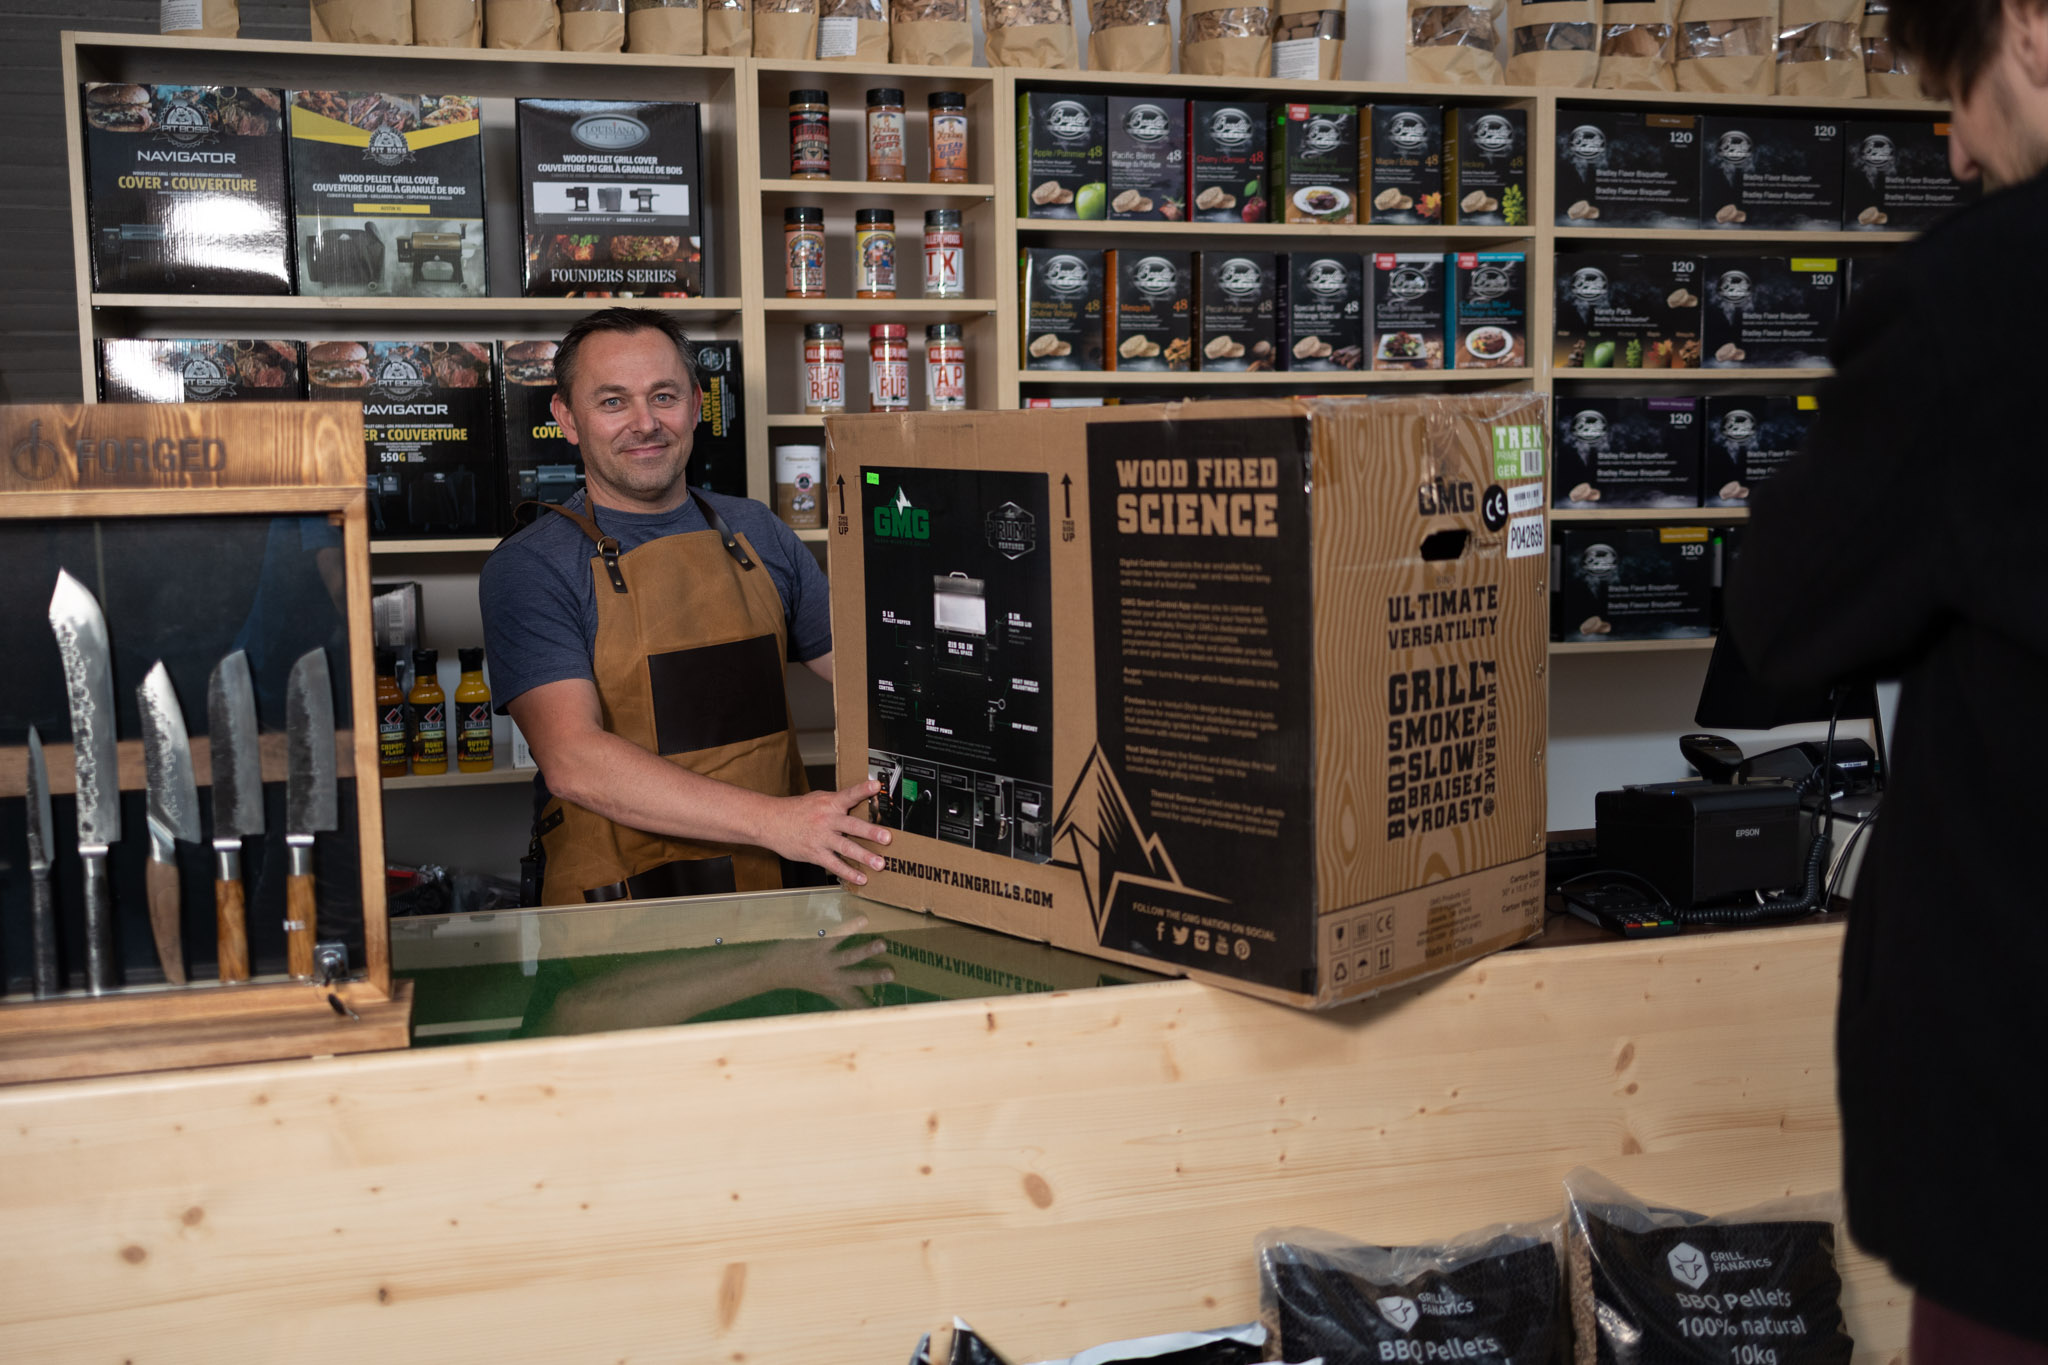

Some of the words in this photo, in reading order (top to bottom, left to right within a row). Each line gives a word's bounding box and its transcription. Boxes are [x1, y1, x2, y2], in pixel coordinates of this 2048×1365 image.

[179, 125, 209, 133] BOSS
[584, 124, 637, 136] LOUISIANA
[1814, 125, 1836, 137] 120
[1670, 132, 1693, 144] 120
[371, 146, 385, 154] PIT
[1088, 146, 1103, 158] 48
[1112, 151, 1134, 160] Pacific
[1136, 151, 1156, 160] Blend
[1166, 150, 1182, 163] 48
[137, 150, 236, 164] NAVIGATOR
[563, 155, 588, 164] WOOD
[588, 156, 613, 164] PELLET
[614, 156, 633, 165] GRILL
[634, 156, 658, 165] COVER
[1250, 152, 1264, 164] 48
[1425, 154, 1440, 166] 48
[1510, 156, 1524, 168] 48
[538, 164, 585, 173] COUVERTURE
[586, 165, 597, 173] DU
[598, 165, 614, 174] GRIL
[614, 163, 621, 174] À
[622, 164, 654, 174] GRANULÉ
[655, 166, 665, 174] DE
[666, 166, 683, 175] BOIS
[118, 176, 161, 189] COVER
[171, 177, 257, 191] COUVERTURE
[339, 174, 364, 183] WOOD
[366, 174, 391, 184] PELLET
[392, 175, 413, 184] GRILL
[414, 176, 439, 185] COVER
[313, 183, 363, 193] COUVERTURE
[364, 184, 375, 193] DU
[376, 184, 393, 194] GRIL
[394, 183, 401, 195] À
[401, 184, 436, 195] GRANULÉ
[437, 186, 447, 195] DE
[448, 186, 466, 195] BOIS
[1672, 262, 1694, 273] 120
[551, 269, 624, 283] FOUNDERS
[627, 270, 677, 283] SERIES
[1812, 274, 1833, 286] 120
[1085, 300, 1100, 312] 48
[1173, 298, 1188, 312] 48
[1258, 301, 1273, 314] 48
[1317, 304, 1334, 312] Blend
[1344, 301, 1359, 314] 48
[1616, 308, 1632, 316] Pack
[808, 365, 840, 380] STEAK
[876, 364, 892, 376] THE
[811, 382, 840, 400] RUB
[880, 378, 907, 398] RUB
[702, 392, 711, 422] COVER
[710, 376, 722, 436] COUVERTURE
[1670, 413, 1692, 425] 120
[388, 429, 468, 441] COUVERTURE
[1496, 426, 1542, 449] TREK
[75, 438, 226, 473] FORGED
[380, 453, 406, 462] 550G
[1497, 450, 1518, 461] PRIME
[1116, 459, 1188, 488] WOOD
[1197, 457, 1278, 488] FIRED
[1497, 464, 1518, 477] GER
[1418, 479, 1475, 516] GMG
[1117, 494, 1278, 538] SCIENCE
[874, 506, 930, 540] GMG
[838, 527, 848, 536] UP
[985, 520, 1037, 541] PRIME
[1063, 533, 1075, 542] UP
[1681, 544, 1704, 556] 120
[1388, 584, 1498, 623] ULTIMATE
[1388, 616, 1498, 650] VERSATILITY
[1389, 661, 1486, 716] GRILL
[1487, 682, 1497, 732] SEAR
[1388, 706, 1475, 752] SMOKE
[1408, 740, 1477, 783] SLOW
[1484, 736, 1496, 795] BAKE
[1408, 774, 1472, 809] BRAISE
[1388, 771, 1406, 842] BBQ
[1422, 796, 1482, 833] ROAST
[1736, 828, 1760, 838] EPSON
[880, 855, 1053, 908] EENMOUNTAINGRILLS.COM
[1132, 902, 1165, 917] FOLLOW
[1166, 909, 1181, 921] THE
[1182, 912, 1200, 925] GMG
[1202, 916, 1231, 931] NATION
[1232, 922, 1244, 934] ON
[1246, 925, 1277, 942] SOCIAL
[1454, 937, 1473, 948] China
[1710, 1251, 1744, 1262] GRILL
[1713, 1258, 1773, 1272] FANATICS
[1418, 1292, 1446, 1304] GRILL
[1676, 1293, 1722, 1314] BBQ
[1724, 1288, 1792, 1310] Pellets
[1422, 1301, 1474, 1316] FANATICS
[1678, 1316, 1738, 1337] 100%
[1741, 1315, 1806, 1335] natural
[1380, 1340, 1424, 1364] BBQ
[1425, 1338, 1499, 1360] Pellets
[1732, 1344, 1777, 1365] 10kg
